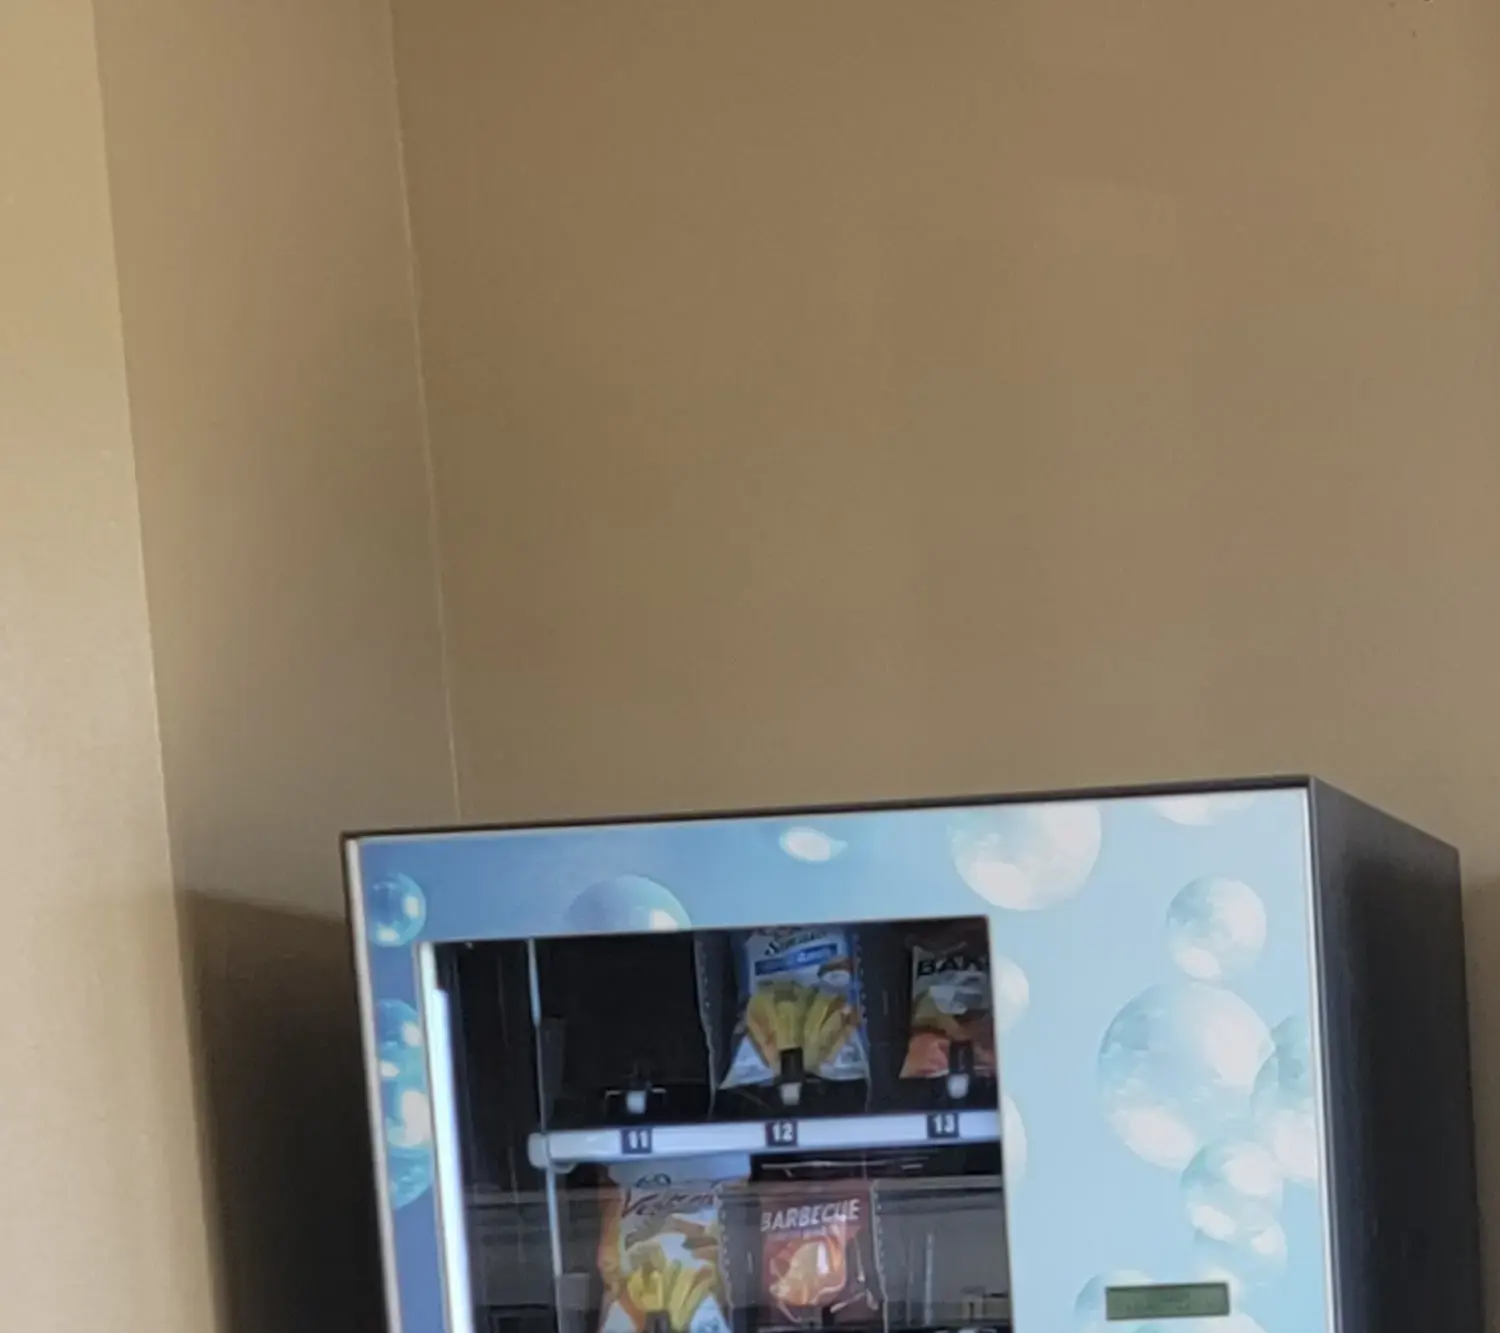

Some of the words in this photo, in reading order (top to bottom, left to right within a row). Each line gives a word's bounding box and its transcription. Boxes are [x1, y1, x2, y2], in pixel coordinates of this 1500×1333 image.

[628, 1129, 649, 1149] 11
[771, 1122, 794, 1142] 12
[761, 1199, 860, 1233] BARBECUE
